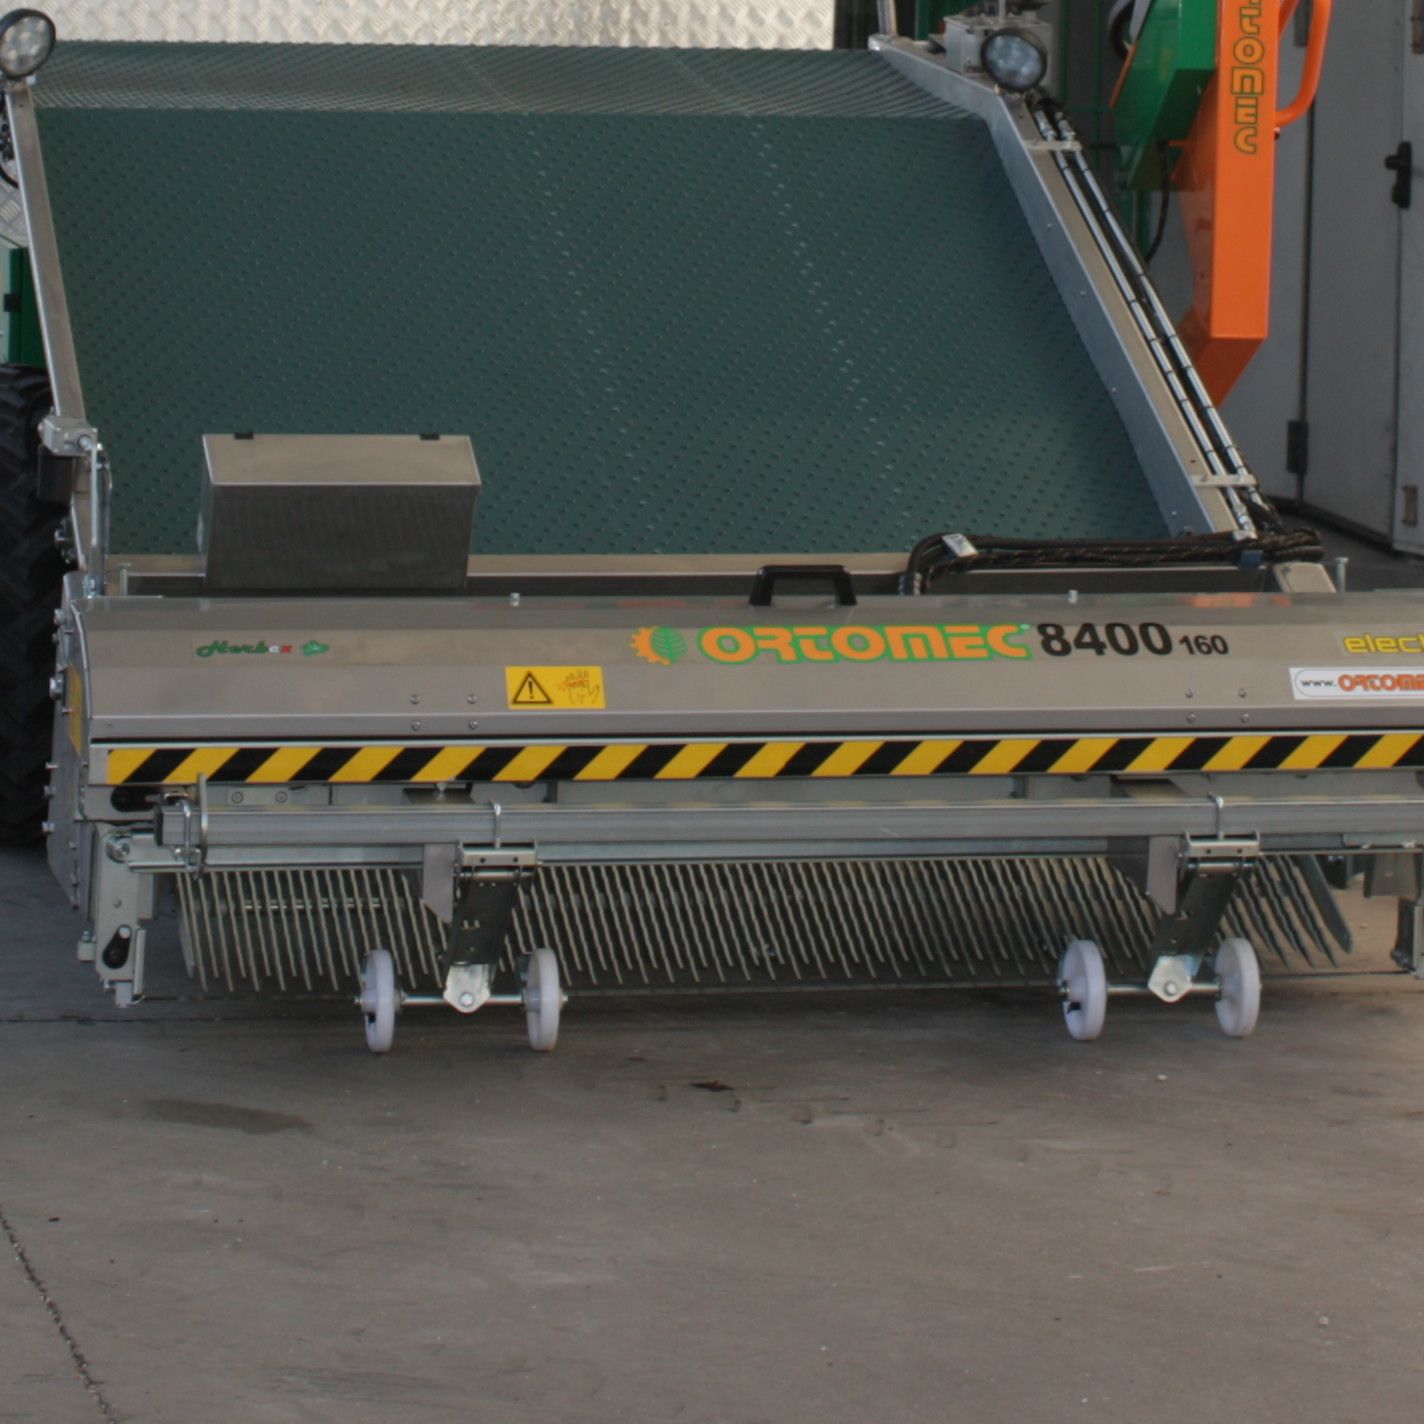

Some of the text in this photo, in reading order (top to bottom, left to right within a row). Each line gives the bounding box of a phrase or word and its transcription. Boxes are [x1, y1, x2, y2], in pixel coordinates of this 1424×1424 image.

[697, 621, 1229, 662] ORTOMEC 8400 160
